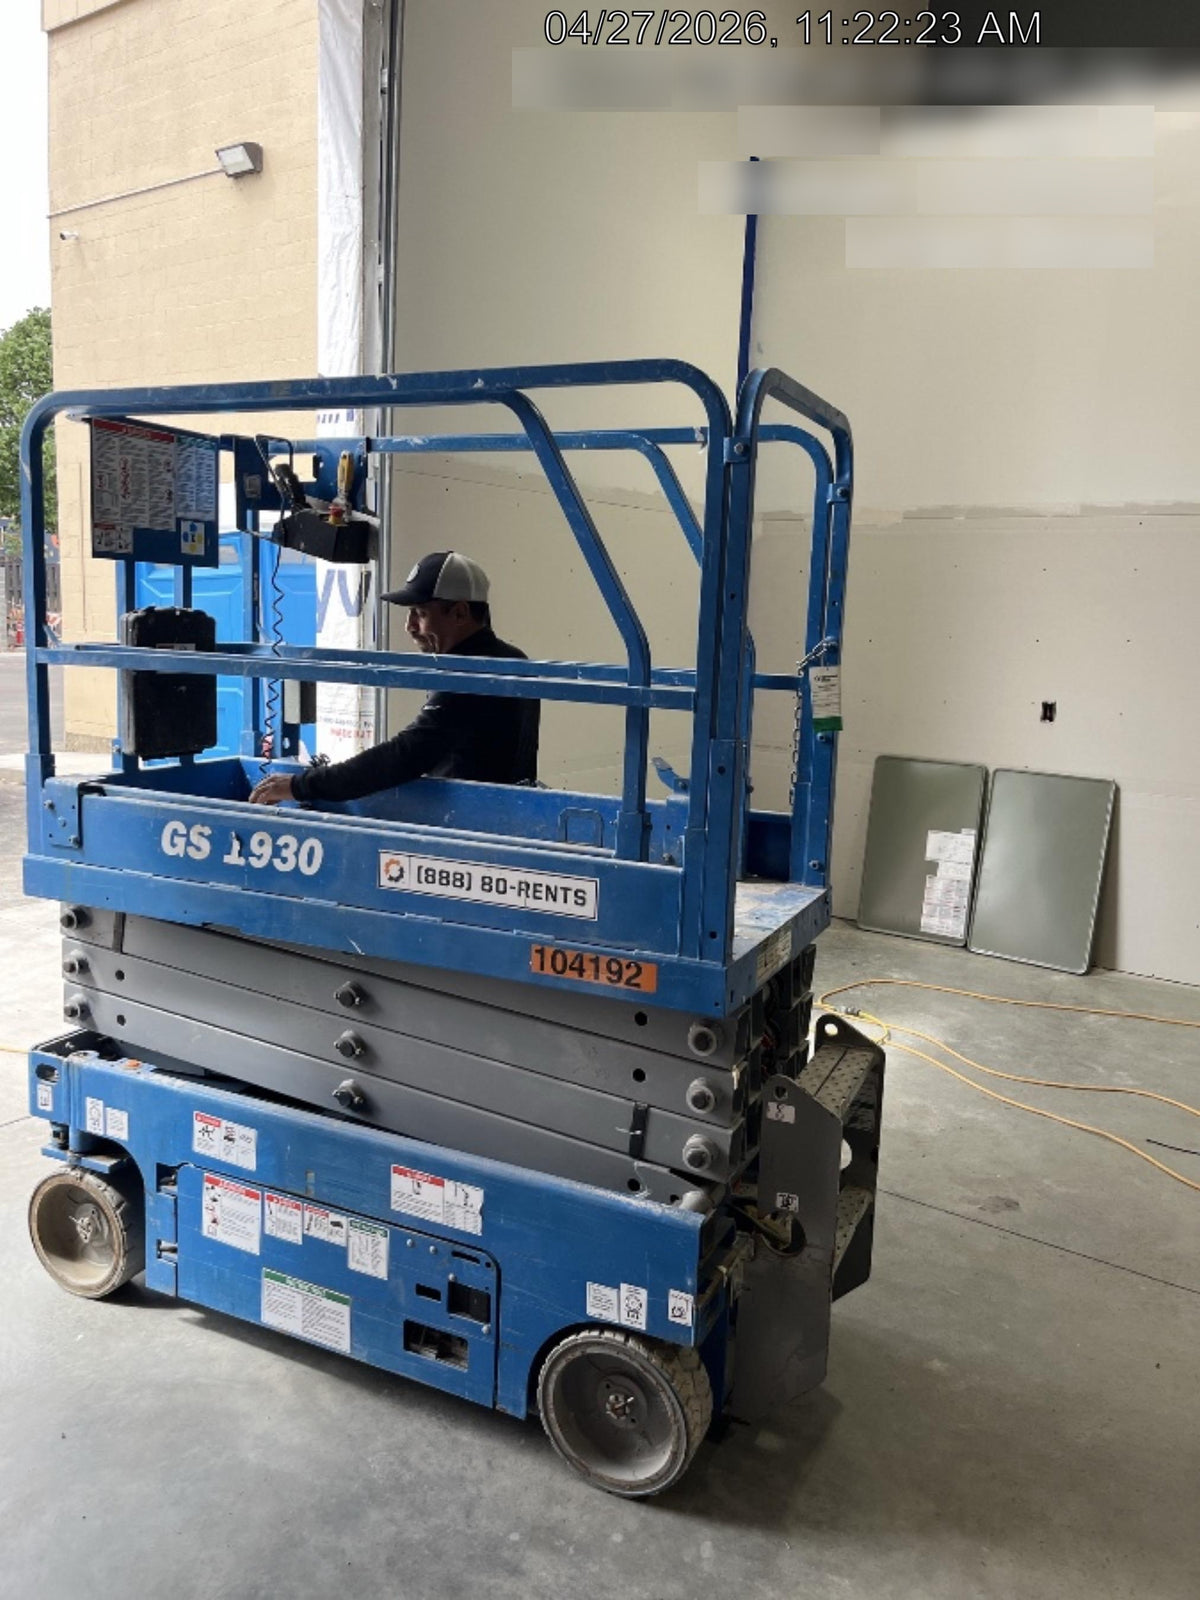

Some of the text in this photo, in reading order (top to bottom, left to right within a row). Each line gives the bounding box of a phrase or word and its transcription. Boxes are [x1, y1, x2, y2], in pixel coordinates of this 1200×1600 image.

[161, 820, 324, 876] GS 1930
[417, 865, 587, 907] (888) 80-RENTS
[534, 946, 643, 989] 104192
